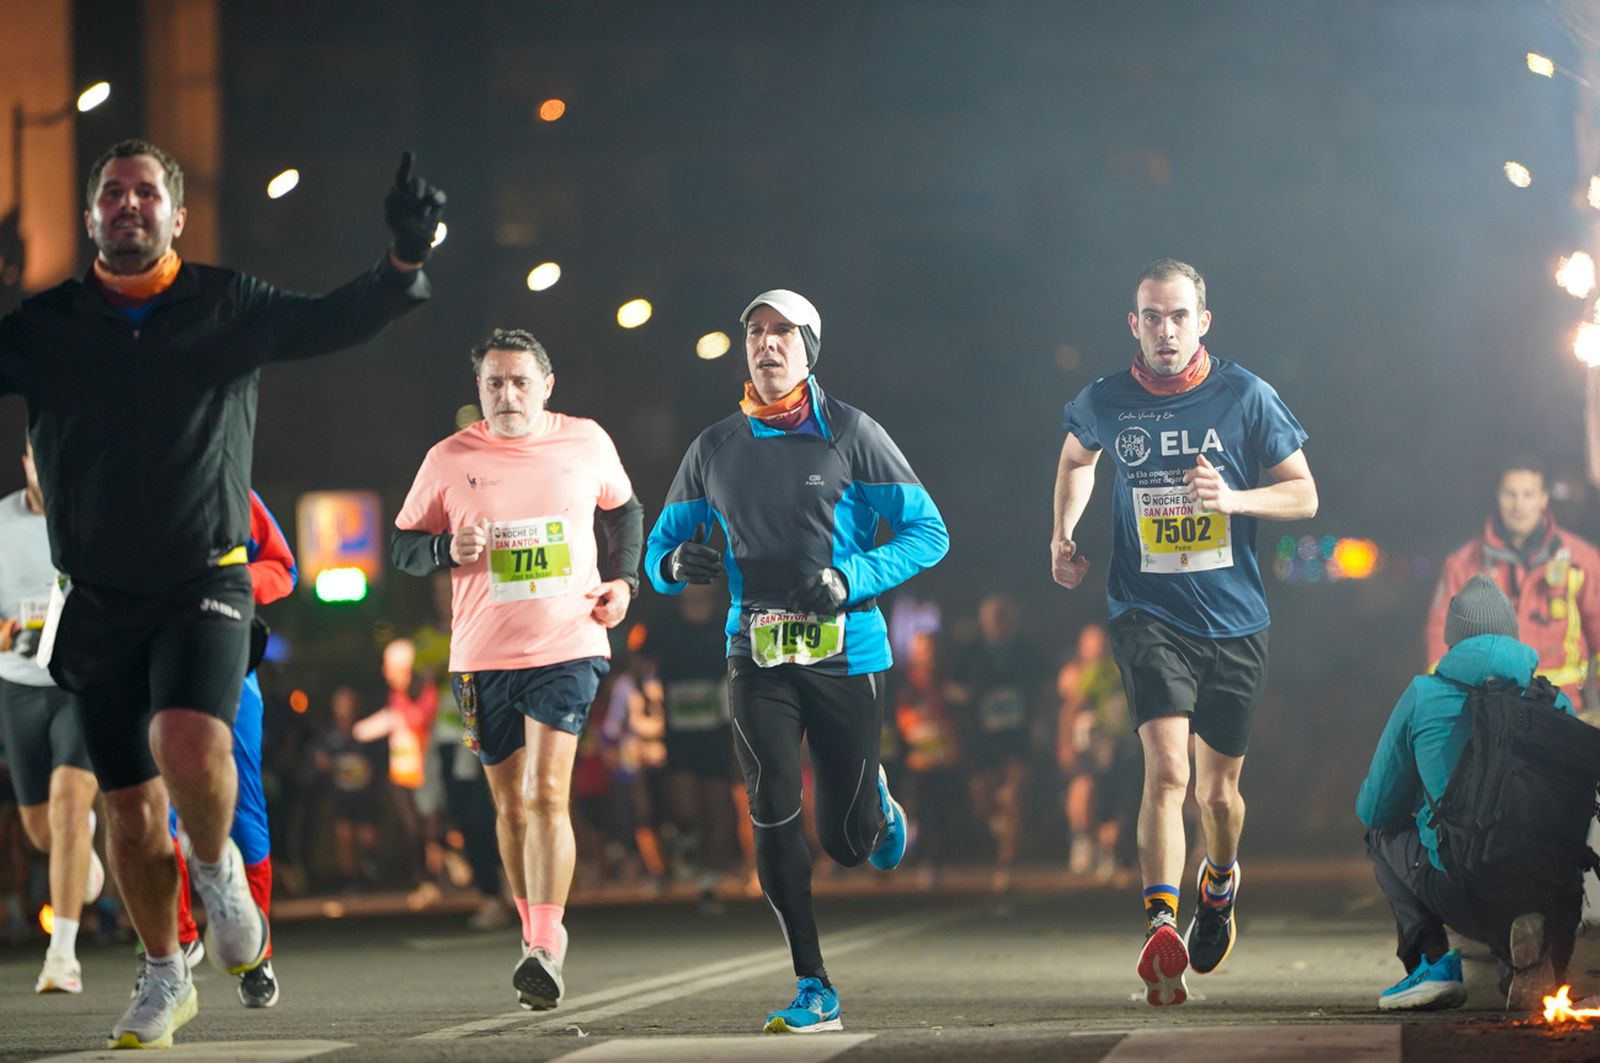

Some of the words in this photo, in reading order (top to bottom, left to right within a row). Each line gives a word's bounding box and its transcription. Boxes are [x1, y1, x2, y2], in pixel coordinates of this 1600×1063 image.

[1160, 428, 1224, 456] ELA
[1152, 495, 1180, 506] NOCHE
[1144, 507, 1160, 517] SAN
[1163, 504, 1194, 516] ANTÓN
[502, 528, 526, 539] NOCHE
[528, 528, 538, 536] DE
[1152, 516, 1211, 543] 7502
[495, 540, 509, 549] SAN
[511, 537, 539, 548] ANTÓN
[511, 547, 548, 573] 774
[760, 615, 777, 626] SAN
[770, 622, 821, 649] 1199
